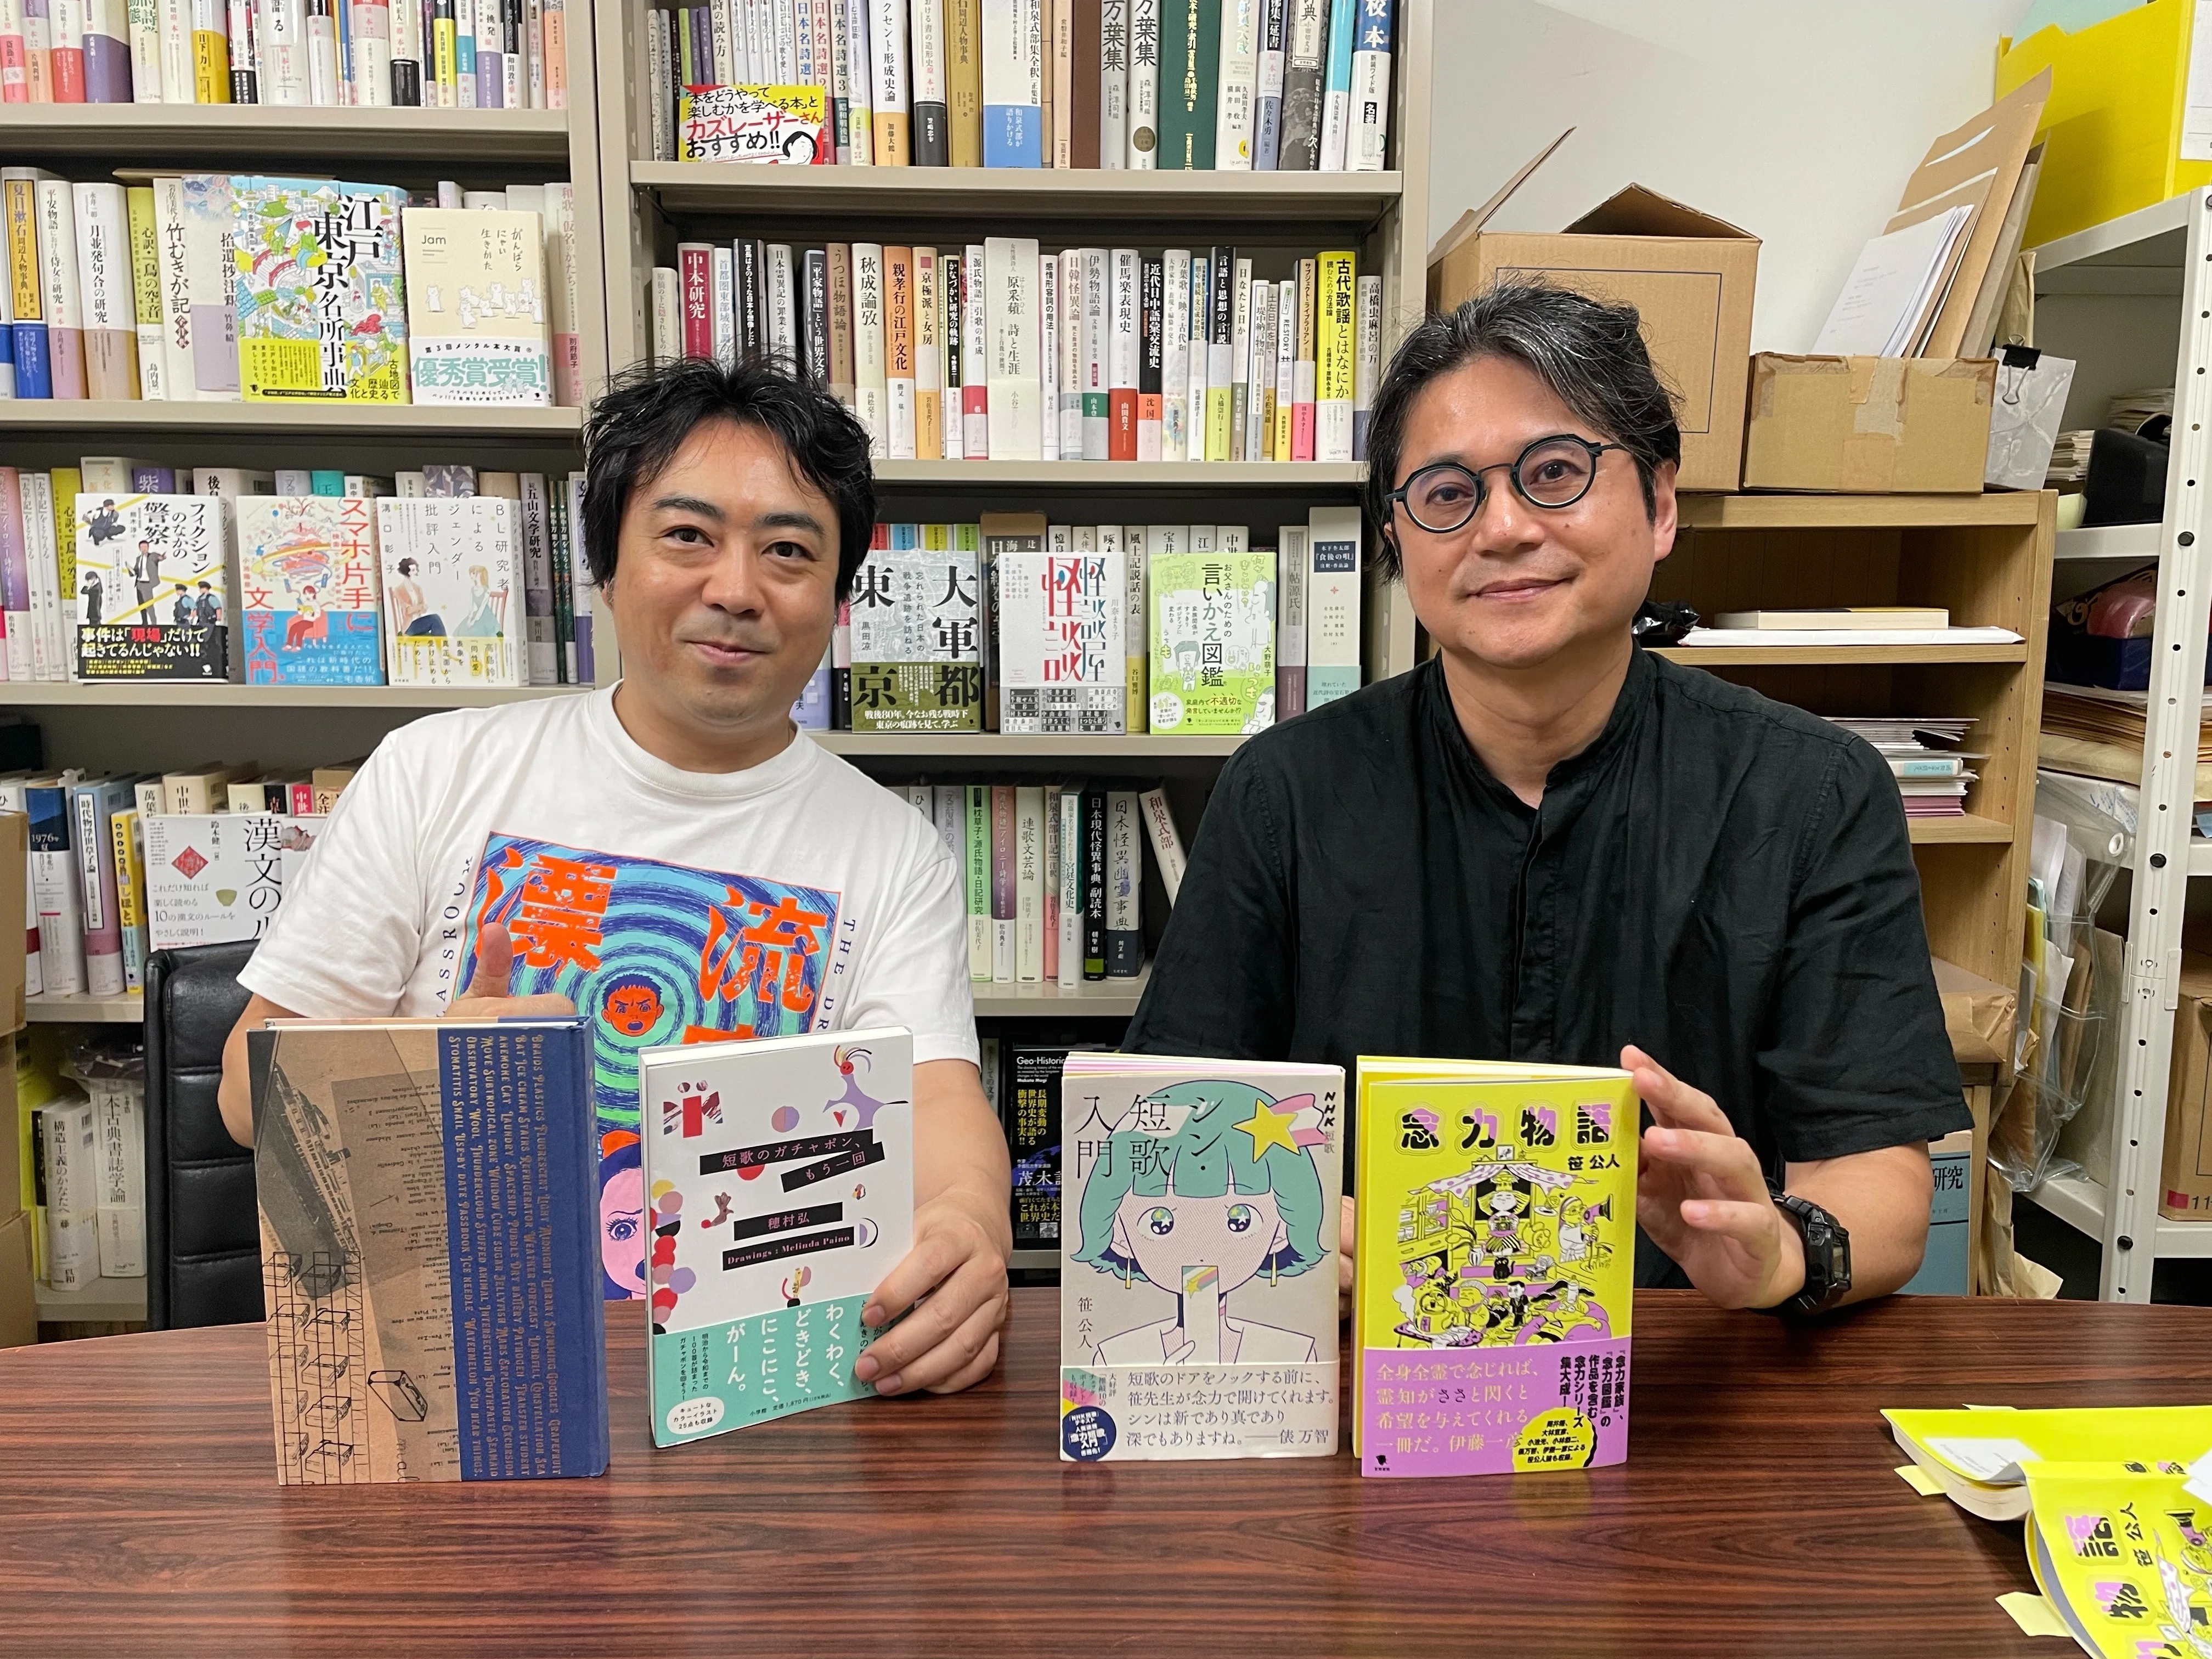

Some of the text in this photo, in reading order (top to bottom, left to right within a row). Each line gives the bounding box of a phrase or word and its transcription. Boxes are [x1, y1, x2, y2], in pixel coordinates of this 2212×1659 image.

[834, 3, 848, 92] 日本名詩選3
[1102, 0, 1125, 72] 万葉集
[1133, 0, 1156, 66] 万葉集
[686, 87, 770, 106] 「本をどうやって
[687, 95, 819, 120] 楽しむかを学べる本」と
[1264, 100, 1274, 136] 佐々木勇
[687, 111, 824, 140] カズレーザーさん
[344, 195, 383, 268] 江戸
[421, 235, 447, 246] Jam
[481, 228, 493, 272] 生きかた
[496, 229, 507, 256] にゃい
[511, 228, 523, 272] がんばら
[89, 225, 108, 324] 月並発句合の研究
[166, 223, 191, 314] 竹むきが記
[687, 253, 706, 319] 中本研究
[833, 250, 847, 331] うつほ物語論
[1045, 262, 1054, 330] 感情形容詞の用法
[1069, 257, 1080, 321] 日韓怪異論
[1089, 255, 1100, 317] 伊勢物語論
[1119, 255, 1131, 332] 催馬楽表現史
[313, 211, 349, 393] 東京名所事典
[893, 263, 908, 371] 親孝行の江戸文化
[921, 272, 933, 345] 京極派と女房
[949, 262, 959, 346] かなづかい研究の軌跡
[1149, 263, 1161, 369] 近代日中語彙交流史
[1216, 255, 1229, 345] 言語と思想の言説
[1303, 263, 1311, 345] サブジェクト・ライブラリアン
[1336, 258, 1352, 399] 古代歌謡とはなにか
[412, 354, 548, 392] 優秀賞受賞！
[1007, 324, 1020, 375] 詩と生涯
[143, 501, 171, 545] 警察
[172, 511, 188, 559] のなかの
[190, 502, 210, 573] フィクション
[425, 504, 442, 575] 批評入門
[449, 504, 463, 582] ジェンダー
[471, 504, 483, 552] による
[495, 504, 510, 591] BL研究者
[340, 499, 375, 631] スマホ片手に
[902, 571, 912, 655] 戦争遺跡を訪ねる
[915, 571, 925, 652] 忘れられた日本の
[1041, 556, 1082, 682] 怪談
[1079, 556, 1107, 682] 怪談屋
[1111, 599, 1120, 640] 川奈まり子
[1200, 563, 1224, 687] 言いかえ図鑑
[1223, 564, 1232, 637] お父さんのための
[81, 627, 208, 644] 事件は「現場」だけで
[861, 621, 871, 651] 黒田涼
[1263, 645, 1272, 677] 大野萌子
[865, 710, 968, 720] 戦後80年。今なお残る戦時下
[1186, 695, 1242, 706] 家庭内で不適切な
[1021, 819, 1035, 882] 連歌文芸論
[1090, 798, 1103, 884] 日本現代怪異事典
[1150, 797, 1175, 851] 和泉式部
[153, 883, 209, 893] これだけ知れば
[973, 809, 984, 915] 枕草子・源氏物語・日記研究
[1065, 862, 1075, 910] 宮廷文化史
[1113, 799, 1130, 932] 日本怪異幽霊事典
[154, 898, 198, 907] 楽しく読める
[1090, 887, 1103, 919] 副読本
[833, 919, 856, 975] THE
[1027, 1089, 1037, 1146] 世界史が語る
[1037, 1089, 1047, 1136] 長期変動の
[1074, 1096, 1114, 1179] 入門
[1129, 1094, 1171, 1178] 短歌
[1323, 1091, 1336, 1127] NHK
[1401, 1104, 1612, 1150] 念力物語
[722, 1136, 862, 1168] 短歌のガチャポン、
[805, 1150, 866, 1181] もう一回
[1567, 1153, 1621, 1172] 笹公人
[768, 1212, 810, 1230] 穂村弘
[1020, 1211, 1060, 1222] 世界史だ
[727, 1233, 851, 1266] Drawings Melinda Paino
[794, 1308, 812, 1395] どきどき、
[825, 1303, 845, 1387] わくわく、
[1077, 1296, 1094, 1350] 笹公人
[701, 1333, 709, 1390] 明治から令和までの
[726, 1323, 746, 1392] がーん。
[760, 1318, 780, 1402] にこにこ、
[1128, 1370, 1321, 1387] 短歌のドアをノックする前に、
[1376, 1359, 1539, 1382] 全身全霊で念じれば、
[673, 1408, 718, 1423] カラーイラスト
[679, 1402, 712, 1414] キュートな
[1128, 1390, 1334, 1407] 笹先生が念力で開けてくれます。
[1376, 1385, 1528, 1406] 霊知がささと閃くと
[1573, 1355, 1586, 1429] 念力シリーズ
[1587, 1355, 1600, 1419] 作品を含む
[678, 1417, 713, 1430] 25点も収録
[1128, 1409, 1285, 1426] シンは新であり真であり
[1376, 1408, 1528, 1430] 希望を与えてくれる
